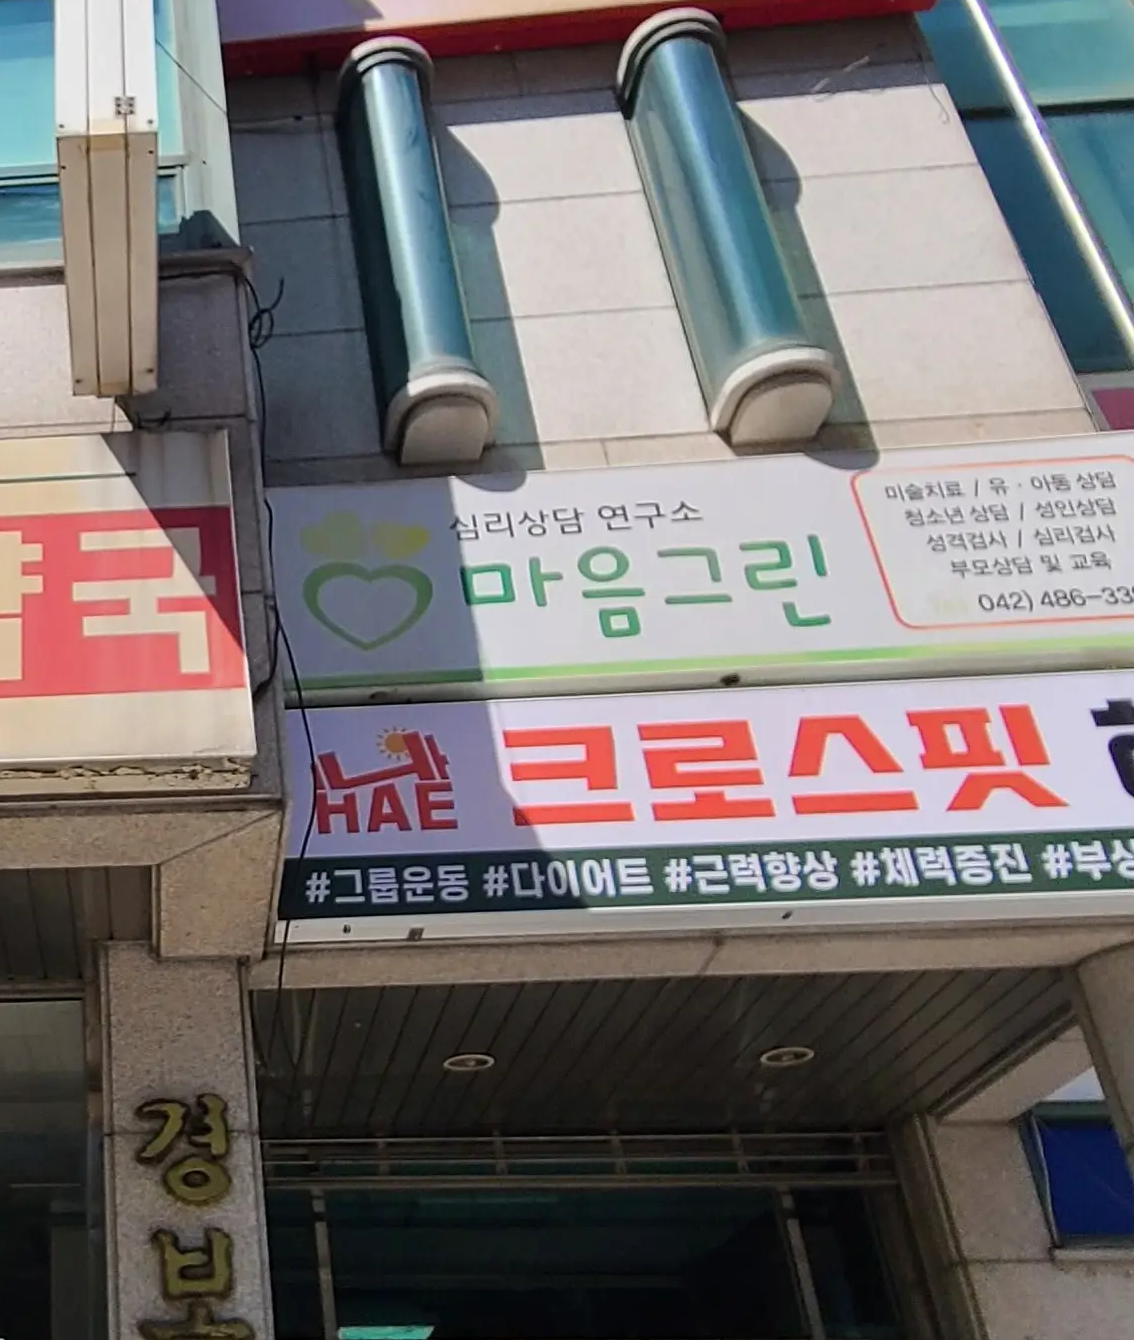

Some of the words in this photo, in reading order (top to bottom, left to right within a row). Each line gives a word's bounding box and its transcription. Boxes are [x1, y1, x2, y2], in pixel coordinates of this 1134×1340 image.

[885, 480, 965, 502] 미술치료
[989, 476, 1010, 497] 유
[1030, 473, 1071, 493] 아동
[1076, 470, 1117, 490] 상담
[450, 507, 584, 541] 심리상담
[597, 500, 704, 531] 연구소
[905, 505, 965, 528] 청소년
[970, 502, 1010, 523] 상담
[1034, 497, 1117, 518] 성인상담
[927, 530, 1008, 552] 성격검사
[1034, 524, 1116, 546] 심리검사
[951, 556, 1034, 579] 부모상담
[1041, 552, 1063, 574] 및
[1071, 550, 1112, 571] 교육
[460, 534, 832, 639] 마음그린
[978, 589, 1034, 612] 042)
[1040, 585, 1134, 608] 486-33
[503, 705, 1072, 826] 크로스핏
[317, 781, 458, 834] HAE
[306, 864, 469, 903] #그룹운동
[483, 857, 654, 900] #다이어트
[665, 849, 839, 895] #근력향상
[851, 842, 1032, 887] #체력증진
